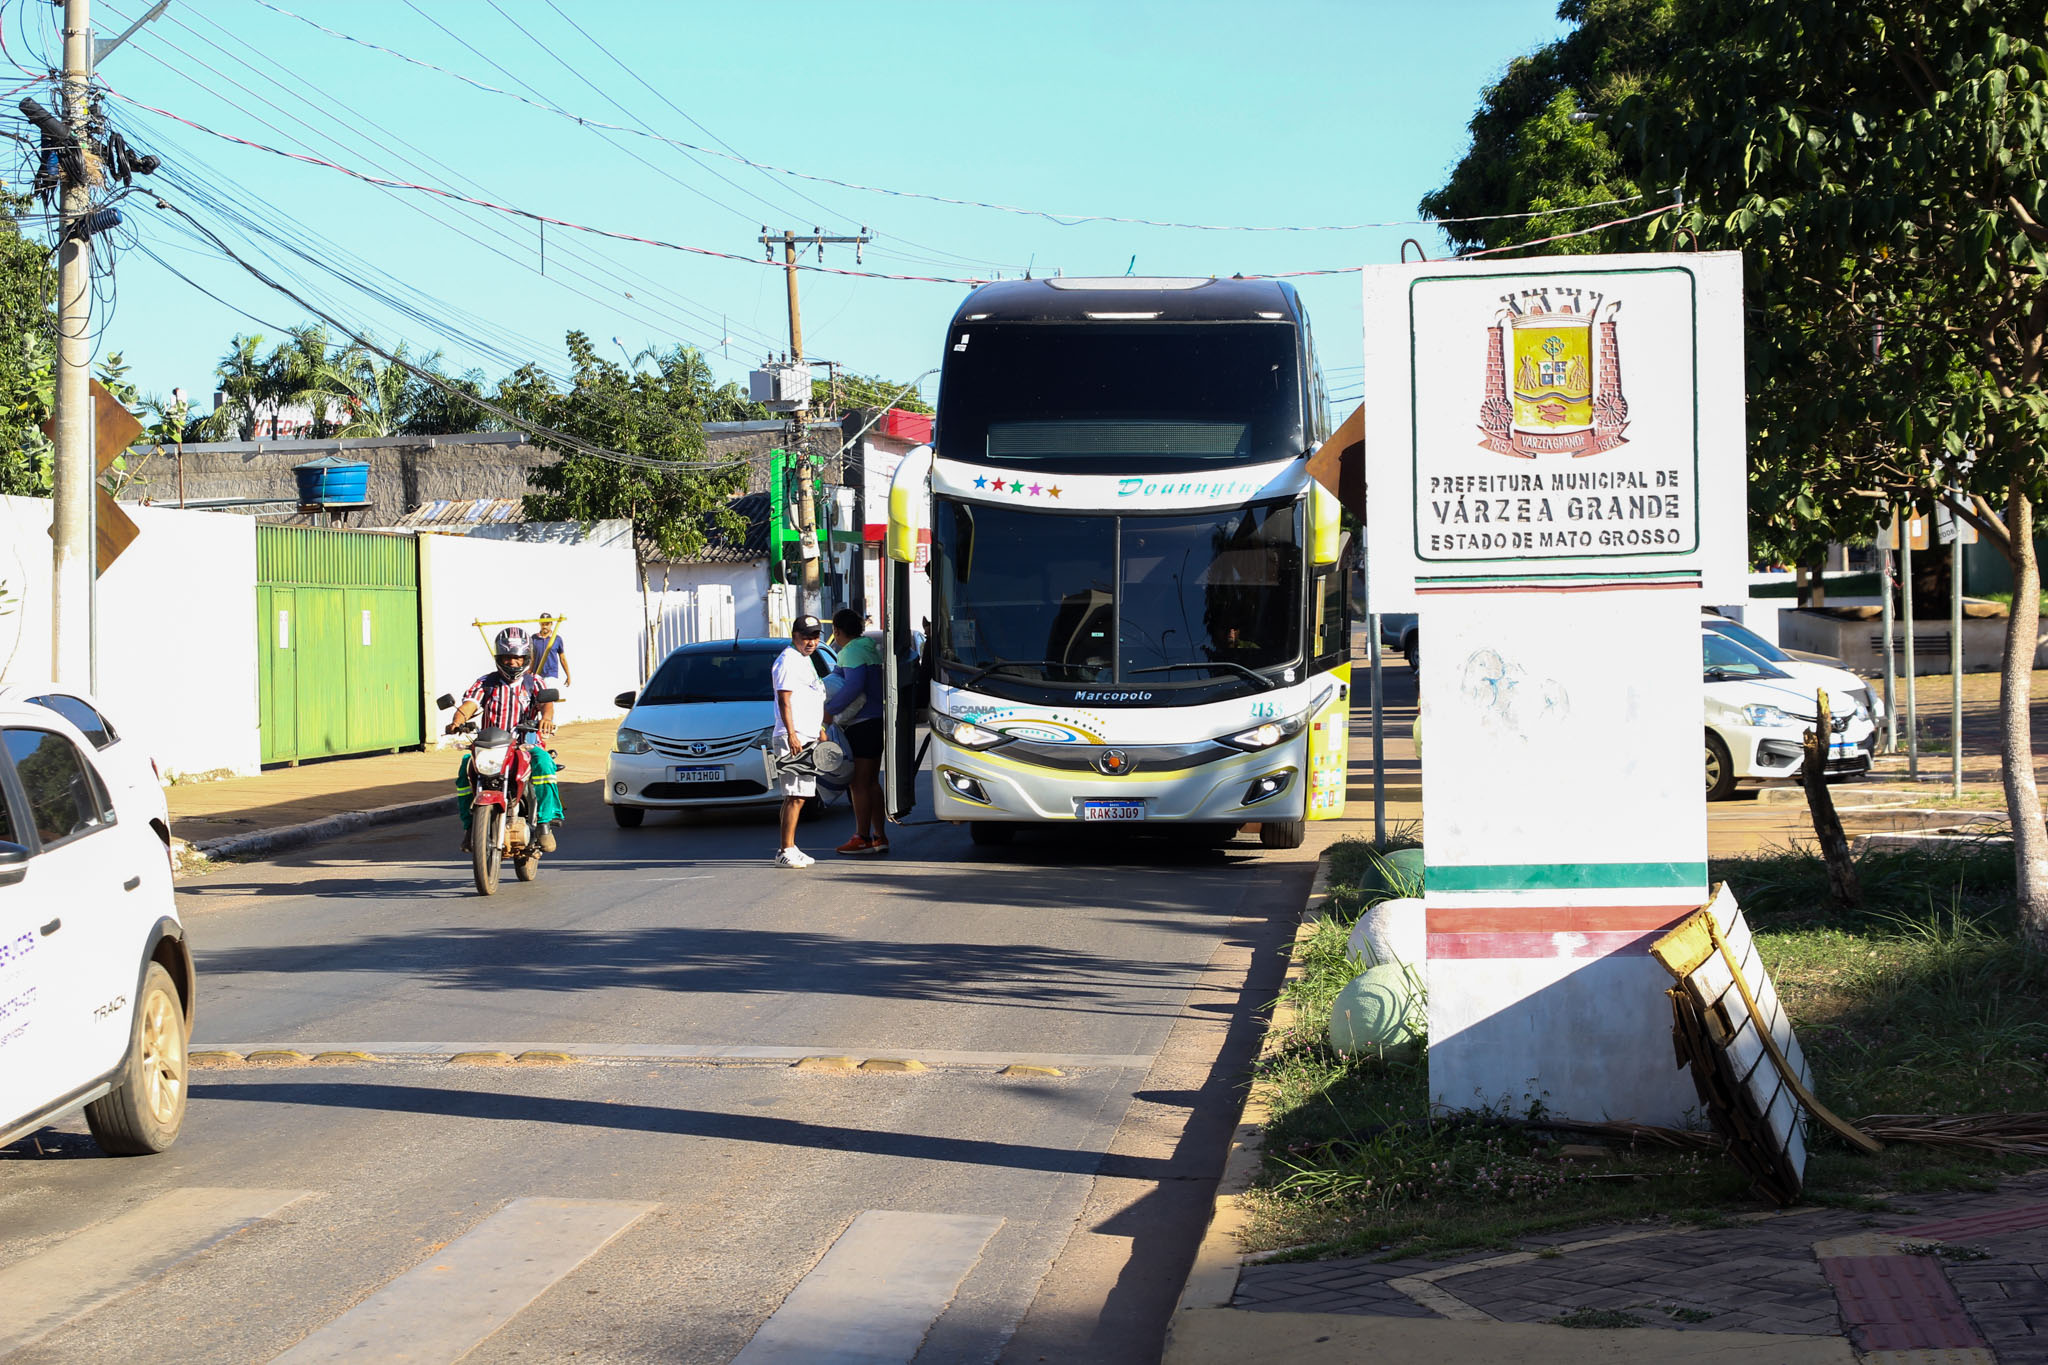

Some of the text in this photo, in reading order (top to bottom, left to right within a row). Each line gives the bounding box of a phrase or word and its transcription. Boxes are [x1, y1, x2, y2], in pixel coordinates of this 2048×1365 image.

[1430, 470, 1679, 494] PREFEITURA MUNICIPAL DE
[1431, 494, 1680, 524] VÁRZEA GRANDE
[1430, 528, 1681, 551] ESTADO DE MATO GROSSO
[1074, 690, 1152, 702] Marcopolo
[950, 705, 998, 715] SCANIA
[1090, 808, 1139, 819] RAK3J09
[93, 994, 127, 1024] TRACK
